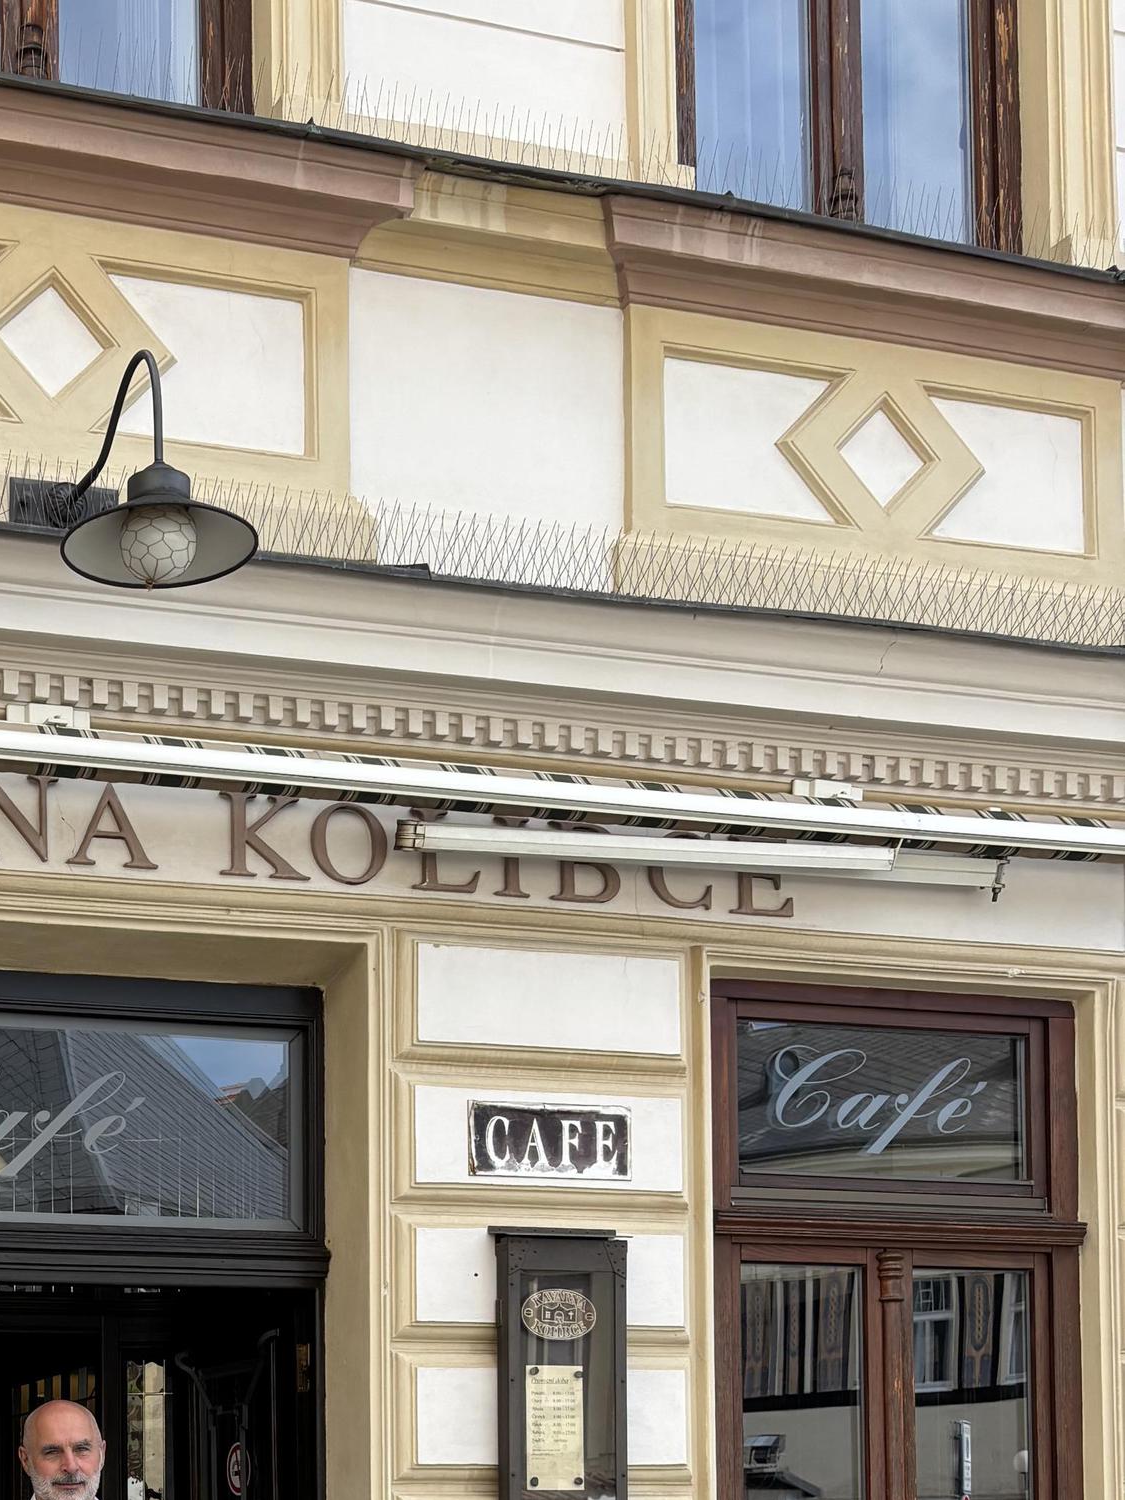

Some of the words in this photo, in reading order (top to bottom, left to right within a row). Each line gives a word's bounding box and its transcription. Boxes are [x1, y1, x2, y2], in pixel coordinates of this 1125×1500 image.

[219, 790, 794, 918] KOLIBCE
[485, 1115, 618, 1171] CAFE
[775, 1044, 988, 1155] Café
